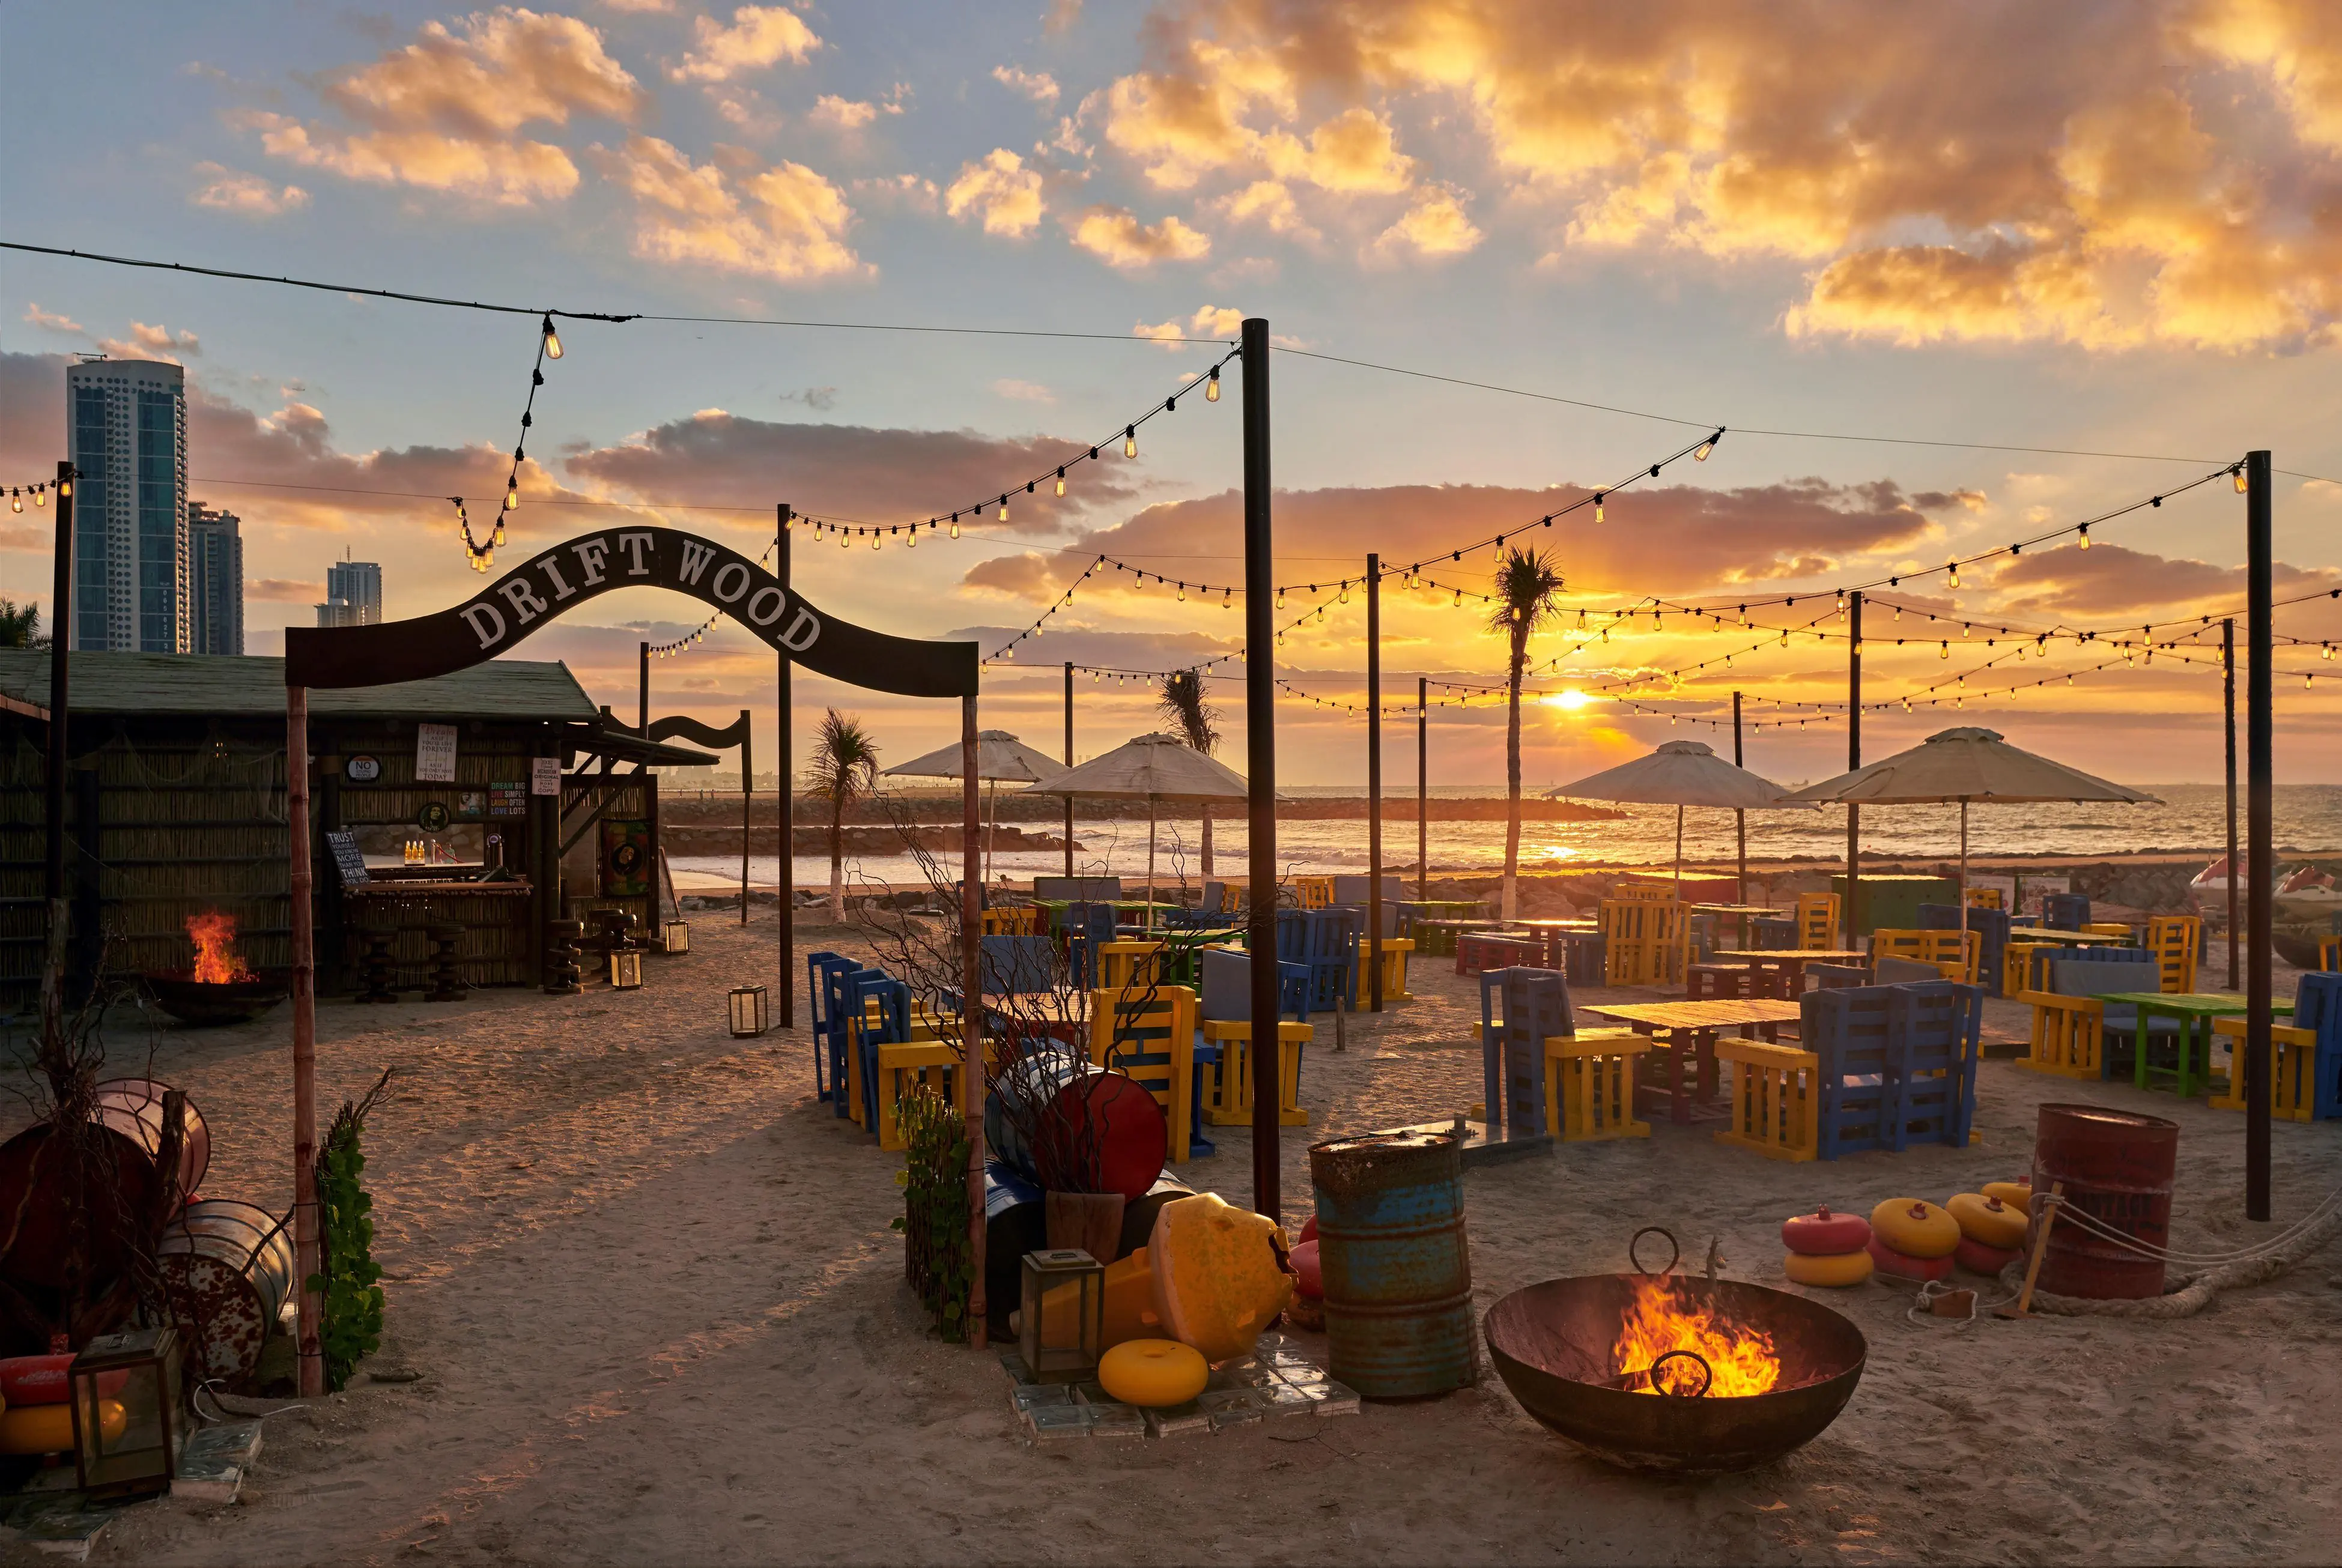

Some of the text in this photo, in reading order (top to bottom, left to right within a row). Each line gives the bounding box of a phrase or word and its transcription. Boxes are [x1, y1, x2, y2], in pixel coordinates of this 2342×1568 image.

[459, 533, 821, 652] DRIFT WOOD
[505, 790, 526, 798] SIMPLY
[509, 807, 526, 815] LOTS
[328, 832, 354, 843] TRUST
[336, 853, 362, 862] MORE
[341, 867, 367, 878] THINK
